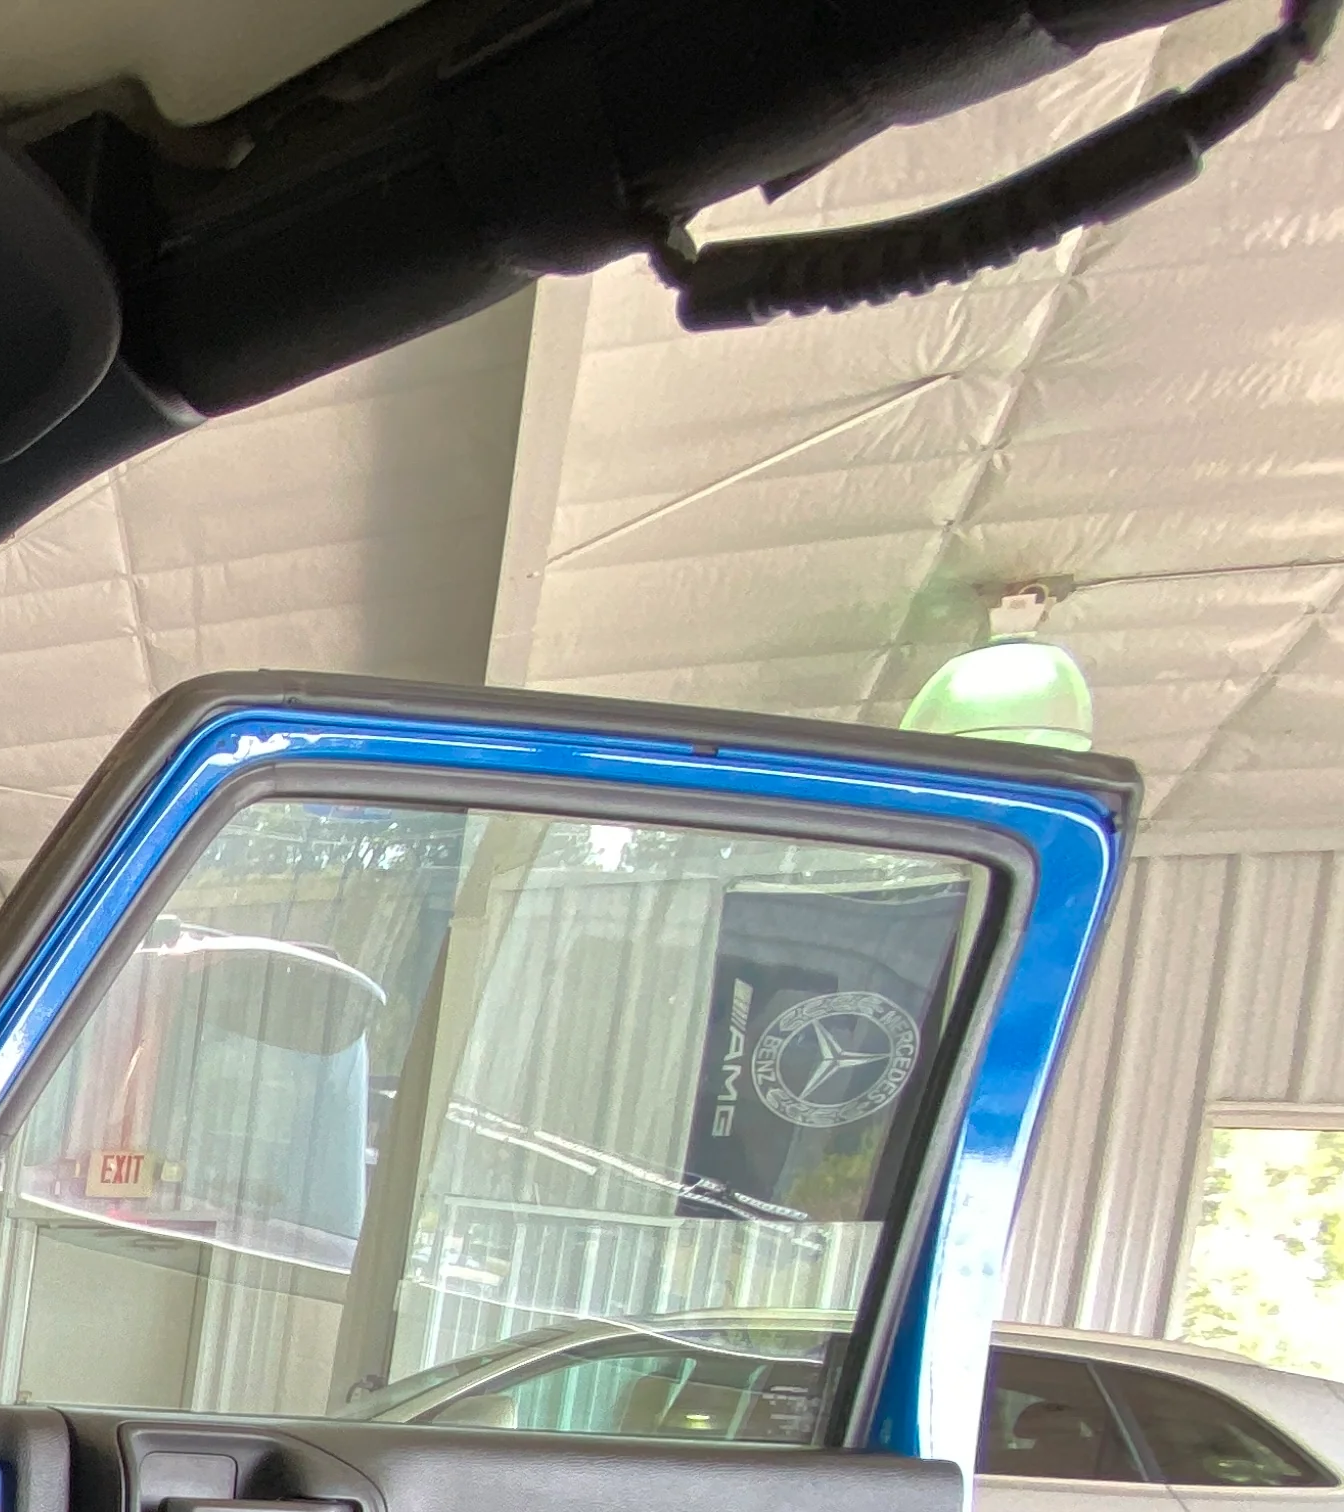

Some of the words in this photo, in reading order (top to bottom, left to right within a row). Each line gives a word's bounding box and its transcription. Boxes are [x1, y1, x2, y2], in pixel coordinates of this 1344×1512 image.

[712, 1025, 746, 1137] AMG
[756, 1035, 784, 1085] BENZ
[867, 1010, 914, 1104] MERCEDES
[100, 1154, 145, 1184] EXIT
